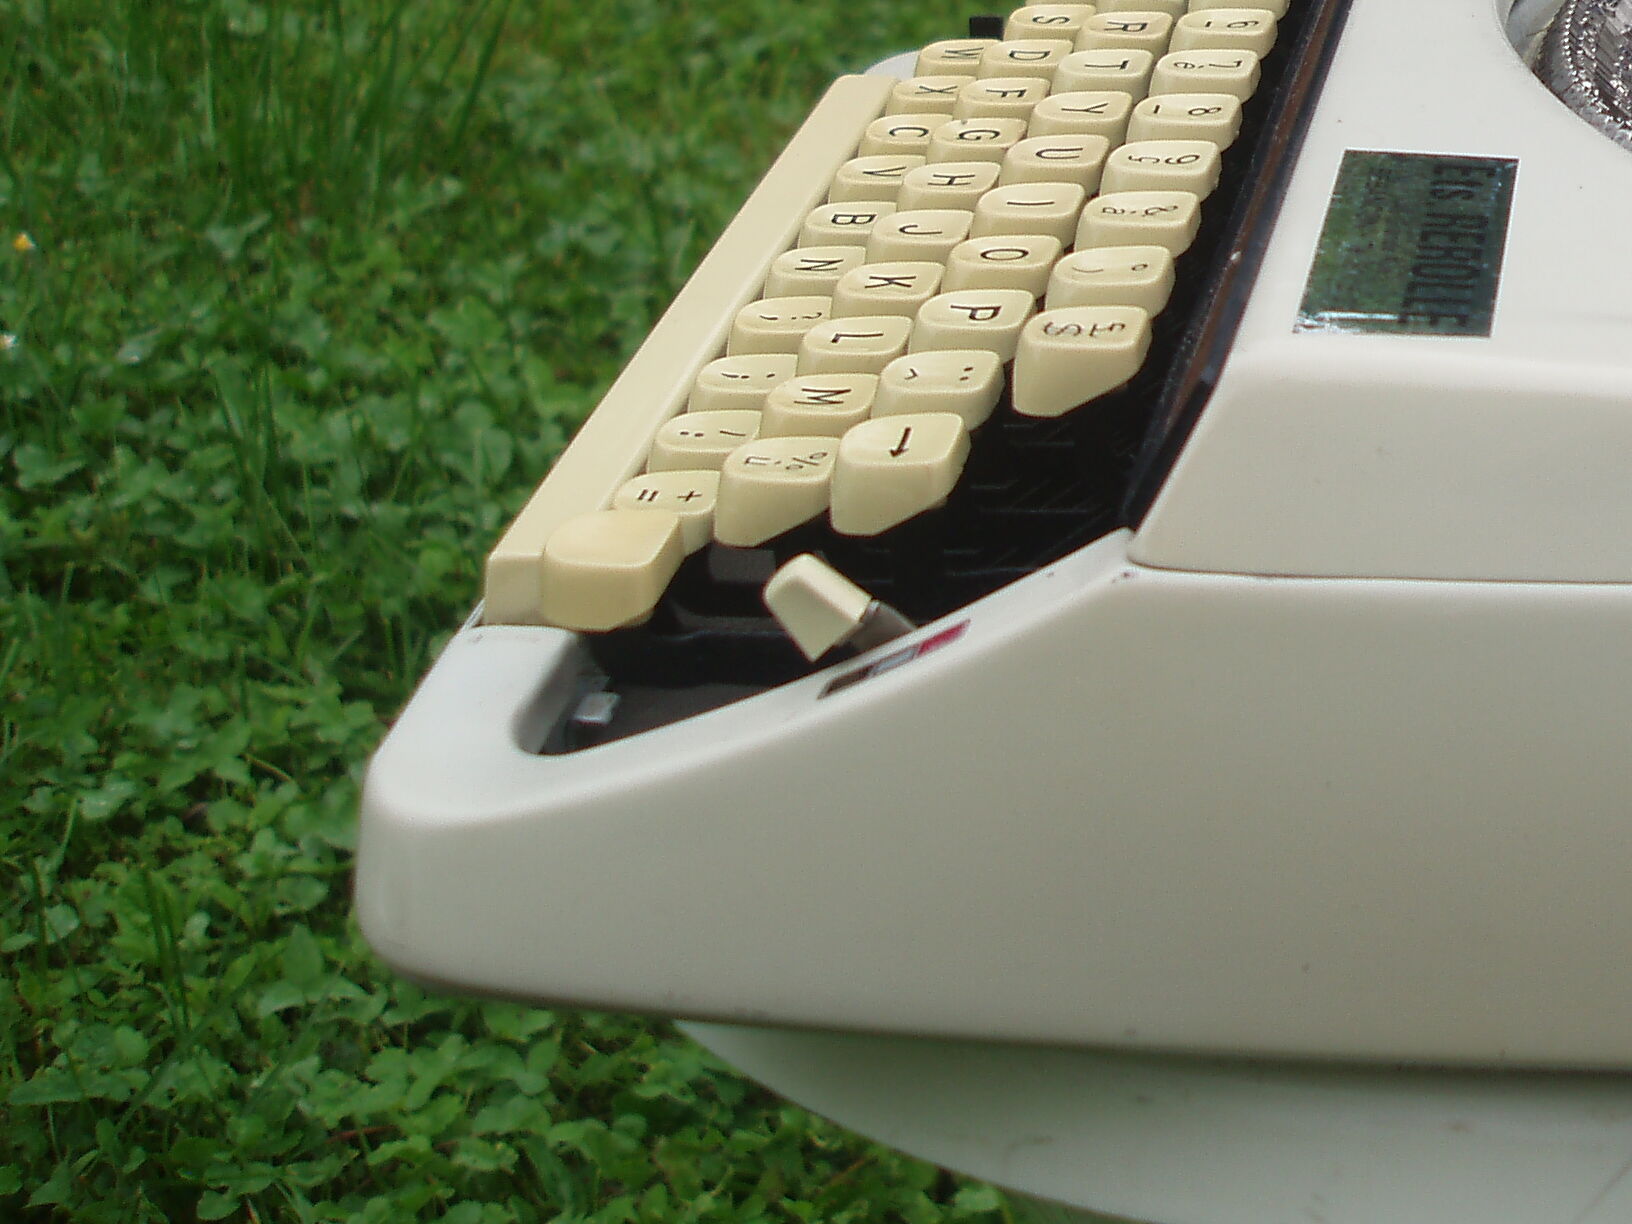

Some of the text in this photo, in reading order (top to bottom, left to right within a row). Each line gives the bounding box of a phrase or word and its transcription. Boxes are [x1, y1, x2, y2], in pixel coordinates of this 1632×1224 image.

[1032, 15, 1071, 25] S
[1226, 20, 1259, 29] 6
[1104, 21, 1149, 33] R
[941, 46, 985, 60] W
[1008, 50, 1052, 61] D
[1084, 59, 1130, 71] T
[1208, 59, 1243, 68] 7
[915, 85, 958, 95] X
[986, 88, 1028, 98] F
[1061, 102, 1109, 114] Y
[1188, 106, 1222, 116] 8
[889, 126, 929, 138] C
[956, 128, 1001, 141] G
[1035, 147, 1084, 160] U
[1164, 154, 1201, 165] 9
[862, 165, 907, 177] V
[927, 173, 976, 186] H
[831, 213, 878, 225] B
[898, 224, 943, 235] J
[980, 248, 1029, 261] O
[794, 258, 844, 272] N
[864, 275, 917, 289] K
[950, 304, 1002, 321] P
[831, 332, 884, 344] L
[793, 388, 852, 405] M
[785, 451, 829, 471] %
